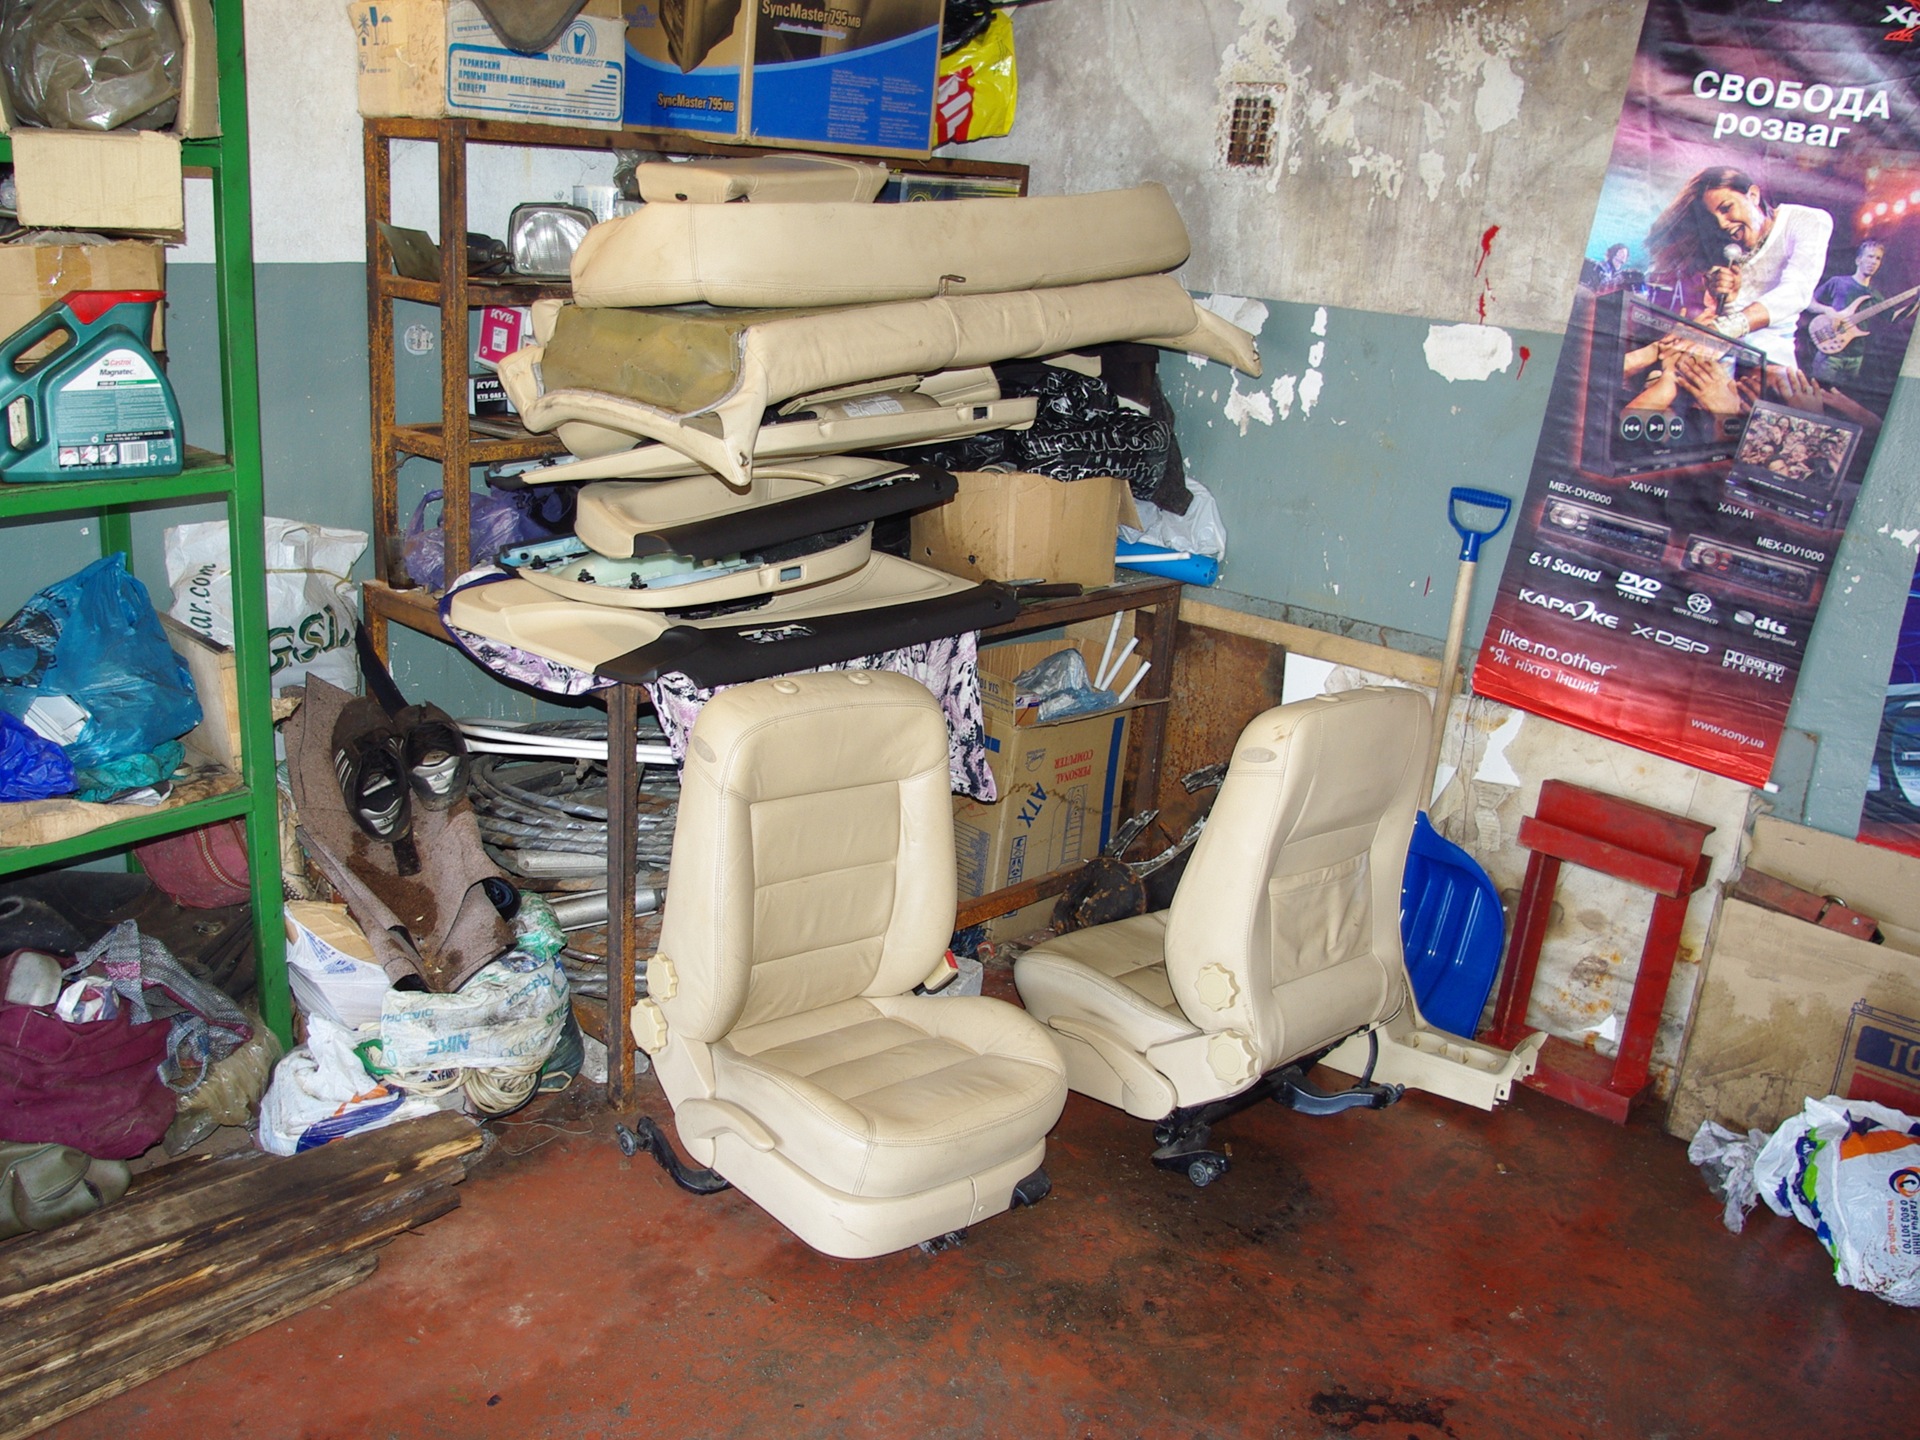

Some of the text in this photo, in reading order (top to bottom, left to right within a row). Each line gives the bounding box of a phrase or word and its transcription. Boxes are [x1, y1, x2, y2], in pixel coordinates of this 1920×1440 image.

[762, 0, 830, 22] SyncMaster
[459, 57, 501, 70] УКРАИНСКИЙ
[551, 53, 605, 68] УКРПРОМИНВЕСТ
[458, 82, 487, 94] КОНЦЕРН
[1693, 70, 1890, 123] СВОБОДА
[657, 91, 707, 110] SyncMaster
[1713, 112, 1850, 148] розваг
[99, 368, 135, 377] Magnatec
[110, 358, 132, 367] Castrol
[1549, 480, 1612, 505] MEX-DV2000
[1629, 480, 1669, 499] XAV-W1
[1717, 502, 1755, 520] XAV-A1
[1756, 536, 1825, 562] MEX-DV1000
[1528, 551, 1602, 583] 5.1 Sound
[1618, 571, 1662, 592] DVD
[1617, 590, 1650, 604] VIDEO
[1753, 628, 1772, 640] Digital
[1754, 616, 1789, 636] dts
[1631, 622, 1710, 655] X-DSP
[1721, 660, 1783, 684] DIGITAL
[1744, 655, 1785, 677] DOLBY
[1514, 659, 1551, 680] ніхто
[1555, 670, 1600, 696] інший
[1690, 718, 1765, 749] www.sony.ua
[1054, 749, 1094, 769] COMPUTER
[1056, 765, 1092, 785] PERSONAL
[1017, 782, 1048, 828] ATX
[427, 1031, 471, 1056] NIKE
[1901, 1207, 1910, 1222] 800
[1901, 1222, 1911, 1238] 301
[1902, 1238, 1912, 1255] 707
